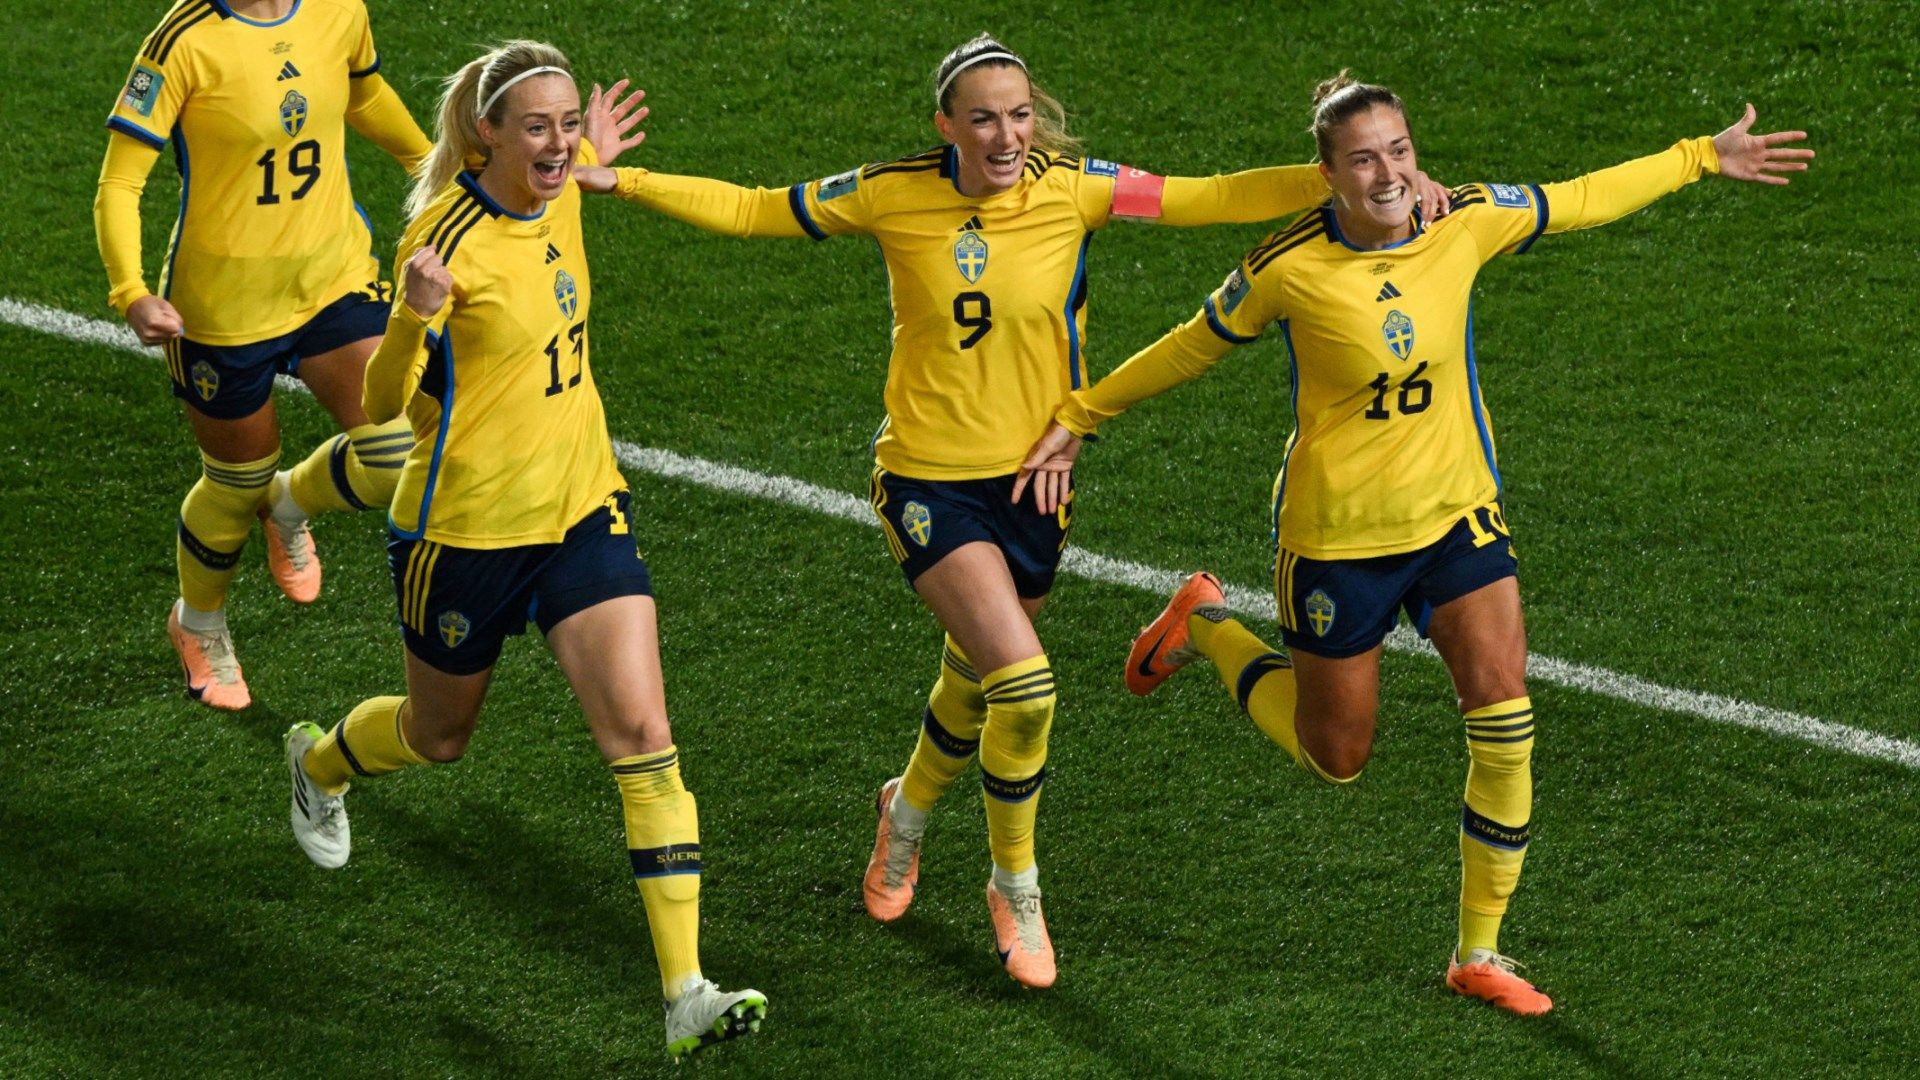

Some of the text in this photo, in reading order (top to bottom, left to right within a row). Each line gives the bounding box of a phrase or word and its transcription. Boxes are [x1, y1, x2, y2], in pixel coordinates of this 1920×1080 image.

[256, 139, 321, 205] 19
[952, 291, 992, 350] 9
[543, 319, 586, 398] 13
[1365, 361, 1433, 420] 16
